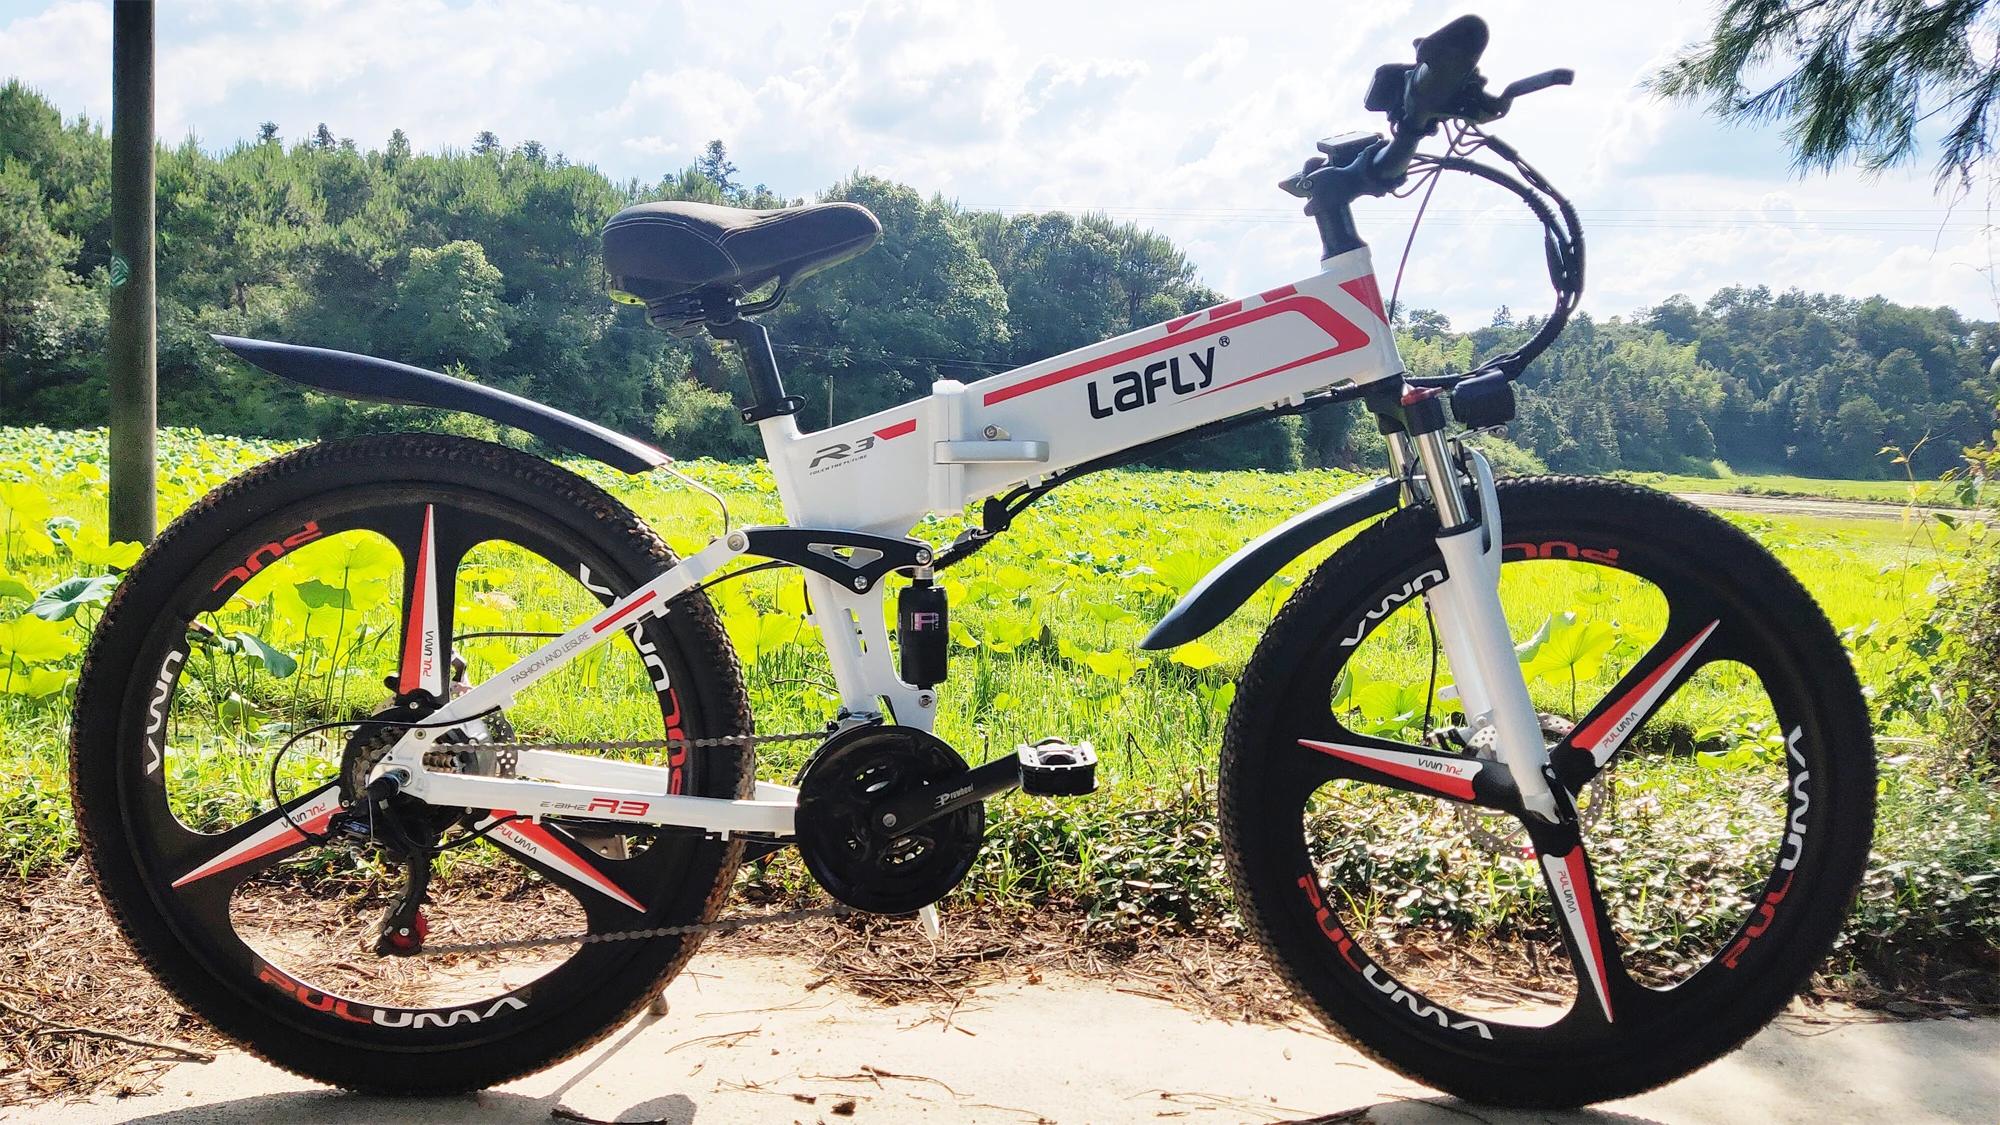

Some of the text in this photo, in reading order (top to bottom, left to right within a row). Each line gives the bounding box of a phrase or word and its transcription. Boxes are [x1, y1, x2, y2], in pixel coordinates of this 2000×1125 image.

[510, 631, 591, 685] FASHION AND LEISURE
